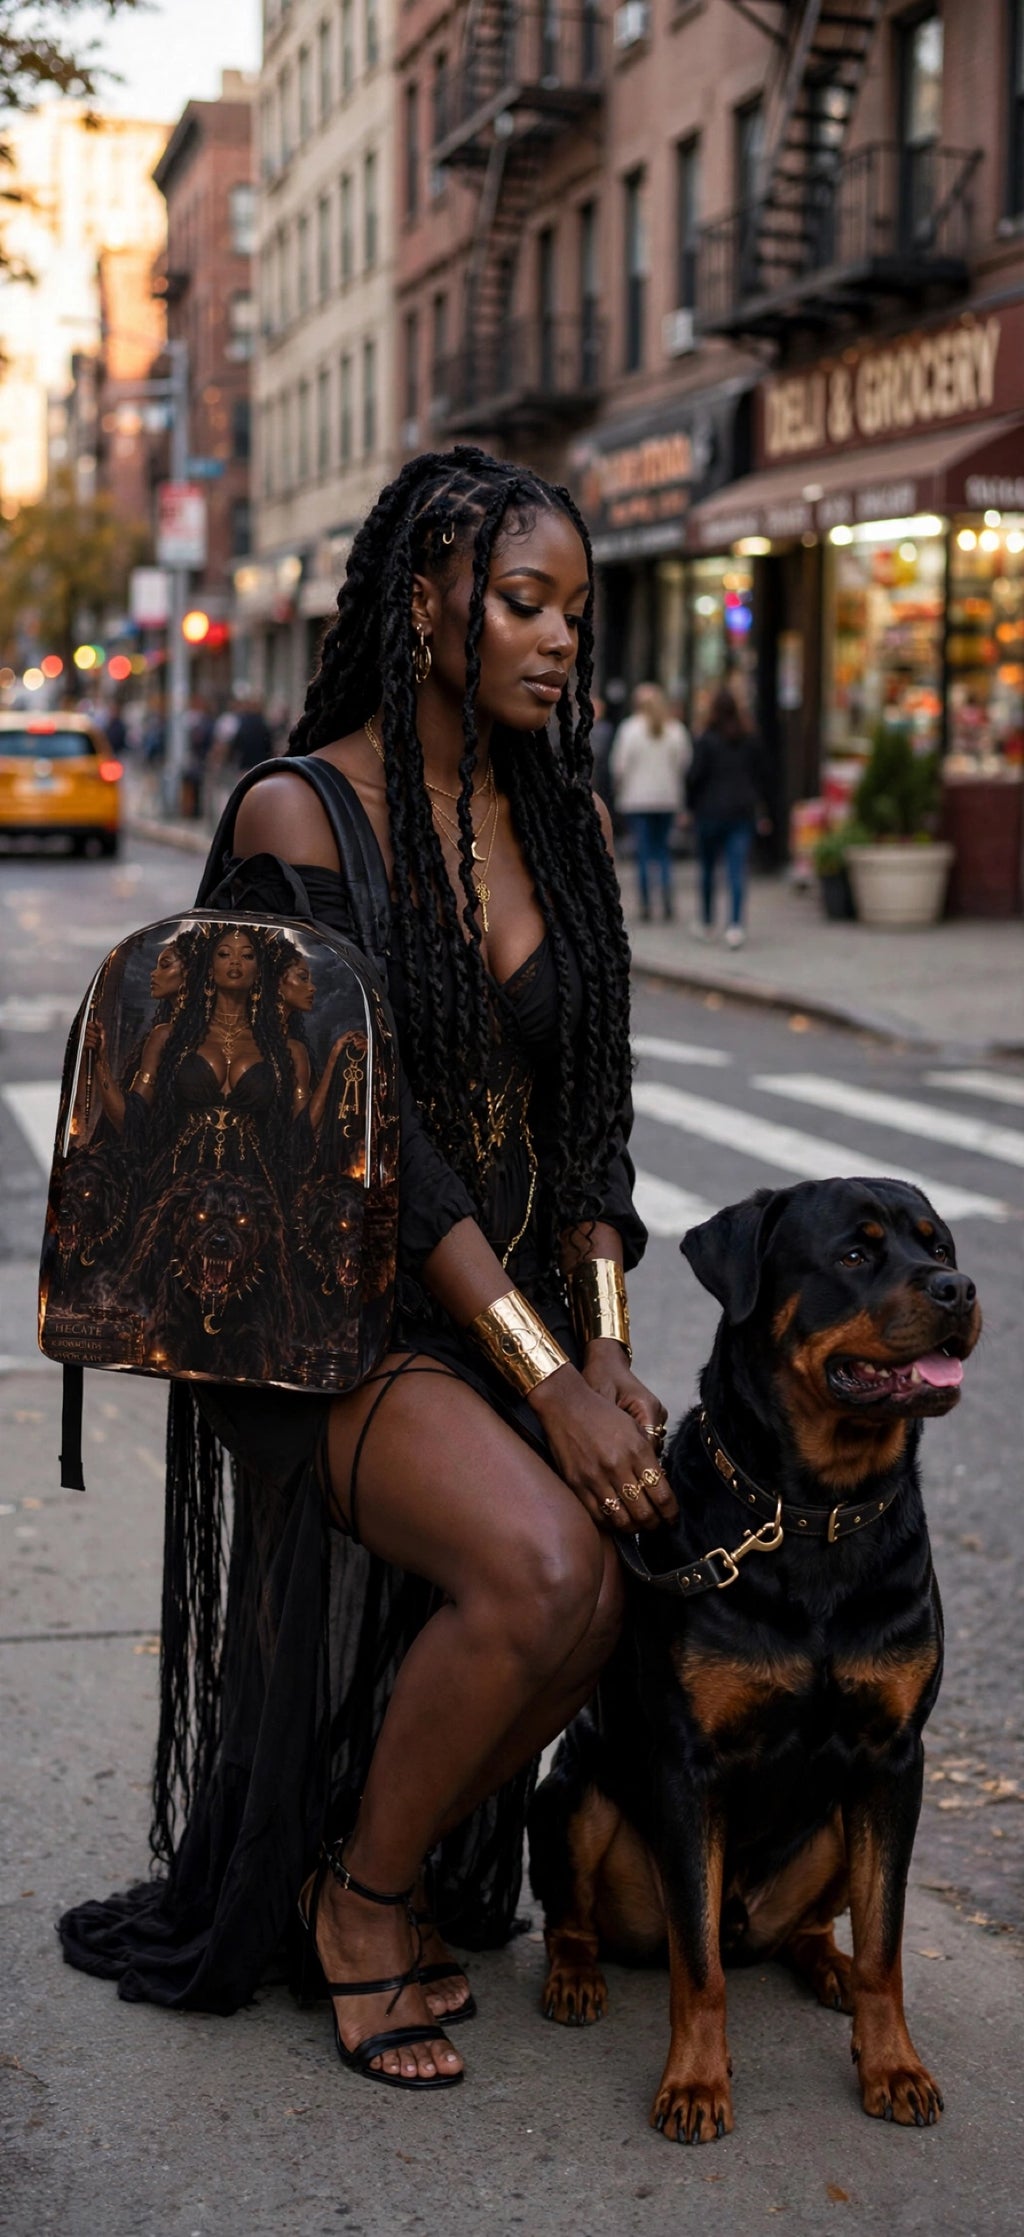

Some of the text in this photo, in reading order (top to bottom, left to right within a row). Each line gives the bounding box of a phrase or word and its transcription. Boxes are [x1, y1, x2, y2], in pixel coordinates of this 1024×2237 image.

[766, 316, 1002, 457] DELI & GROCERY
[55, 1323, 102, 1337] HECATE
